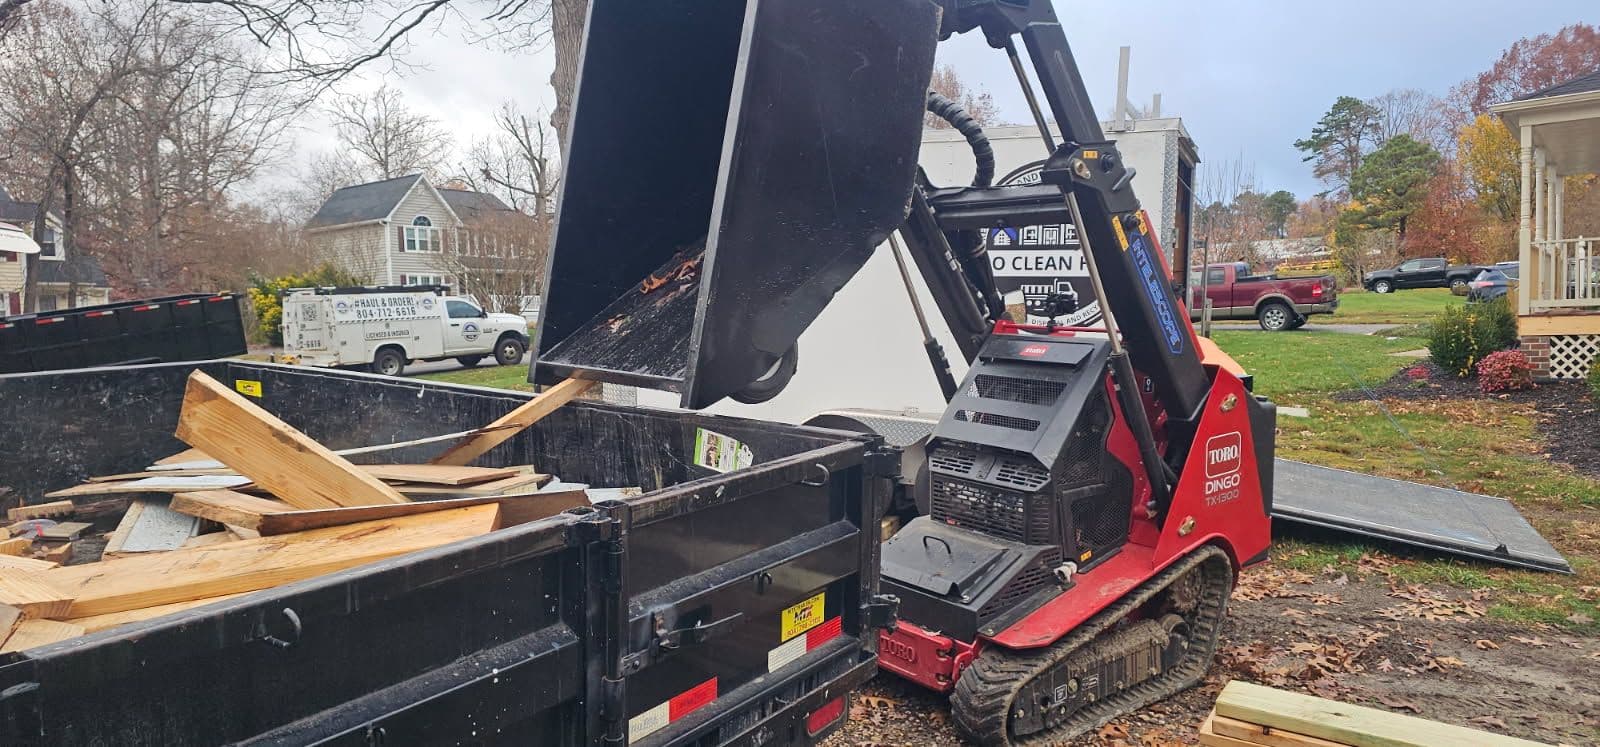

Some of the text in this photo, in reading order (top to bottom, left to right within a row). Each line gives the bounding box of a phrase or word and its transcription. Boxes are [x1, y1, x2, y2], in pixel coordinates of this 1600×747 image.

[1017, 172, 1039, 184] AND
[1012, 256, 1072, 271] CLEAN
[354, 296, 414, 309] #HAUL & ORDER!
[1066, 315, 1081, 325] AND
[1208, 444, 1239, 465] TORO
[1205, 473, 1241, 495] DINGO
[880, 635, 916, 662] TORO
